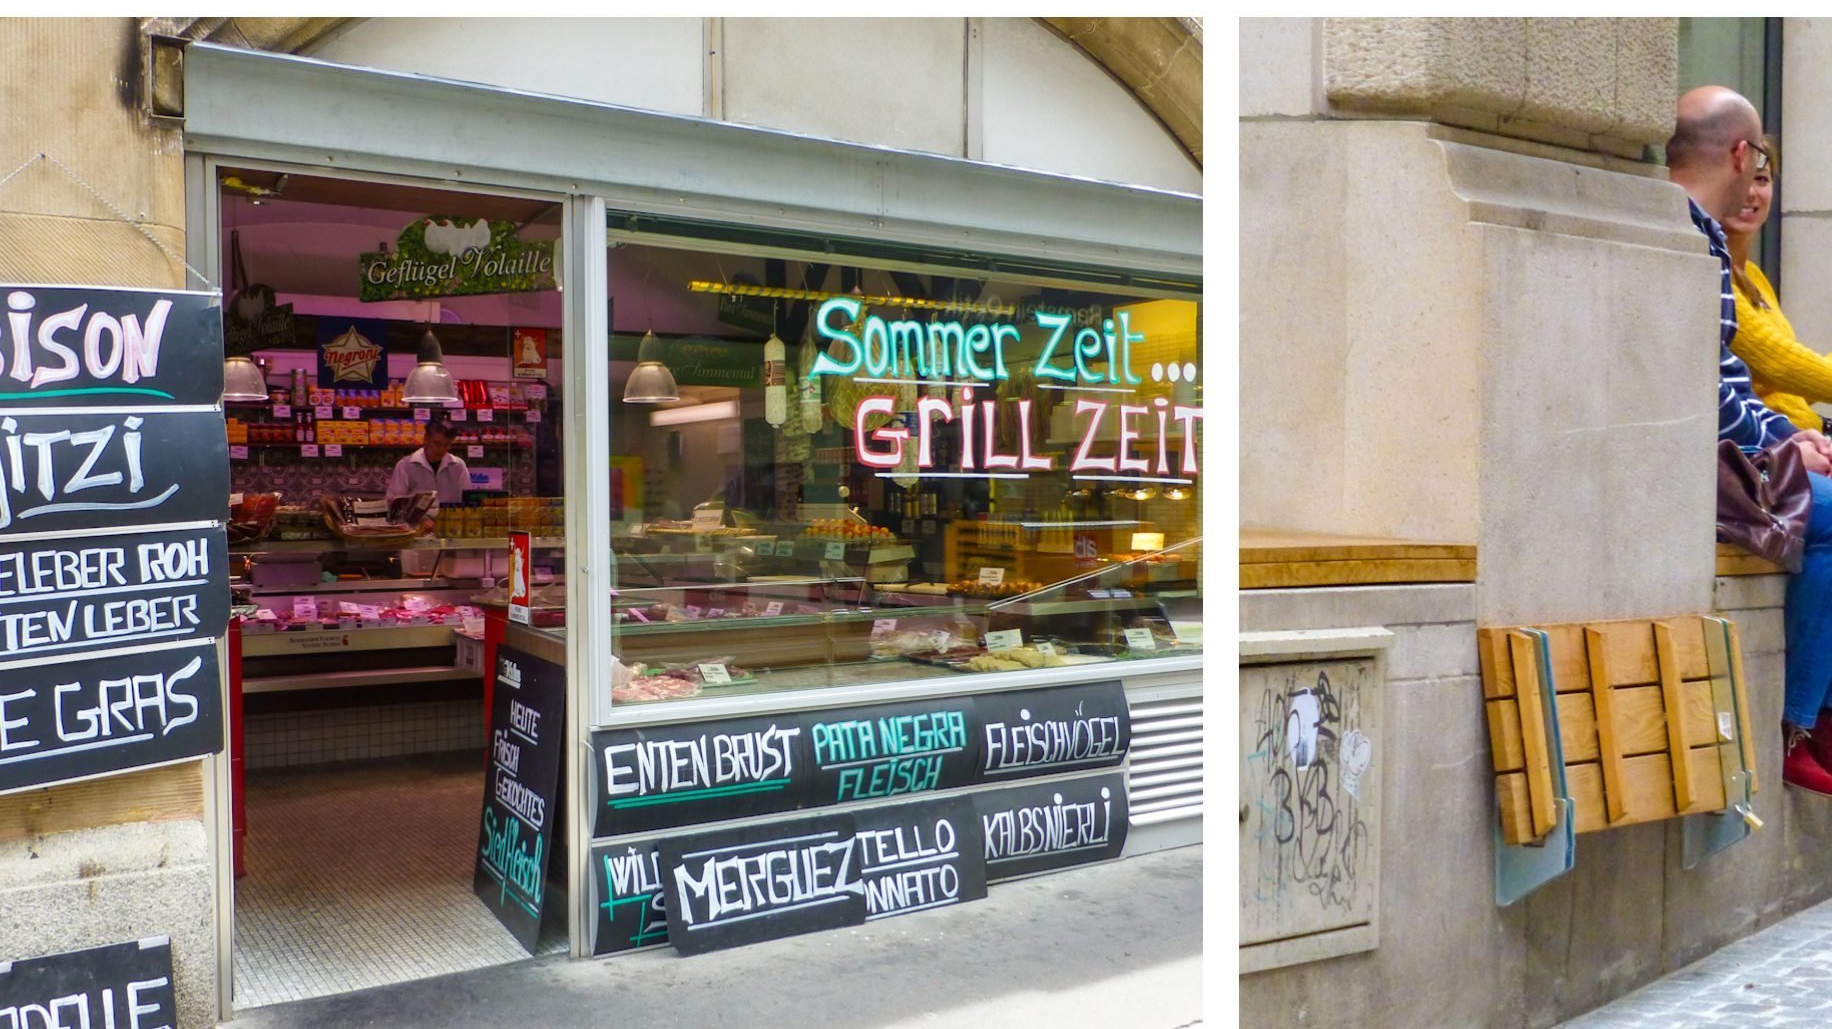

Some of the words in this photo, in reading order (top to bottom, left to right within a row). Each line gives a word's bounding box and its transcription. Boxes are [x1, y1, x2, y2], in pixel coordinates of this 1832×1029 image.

[367, 256, 458, 288] Geflügel
[460, 246, 551, 279] Volaille
[809, 298, 1020, 381] Sommer
[1035, 311, 1144, 385] Zeit
[138, 538, 209, 583] ROH
[55, 656, 202, 742] GRAS
[510, 698, 541, 739] HEUTE
[811, 719, 875, 764] PATA
[878, 710, 967, 757] NEGRA
[495, 768, 545, 827] GEKOCHTES
[482, 806, 543, 904] Siedfleisch
[855, 819, 956, 866] TELLO
[673, 836, 865, 924] MERGUEZ
[864, 863, 960, 914] NNATO
